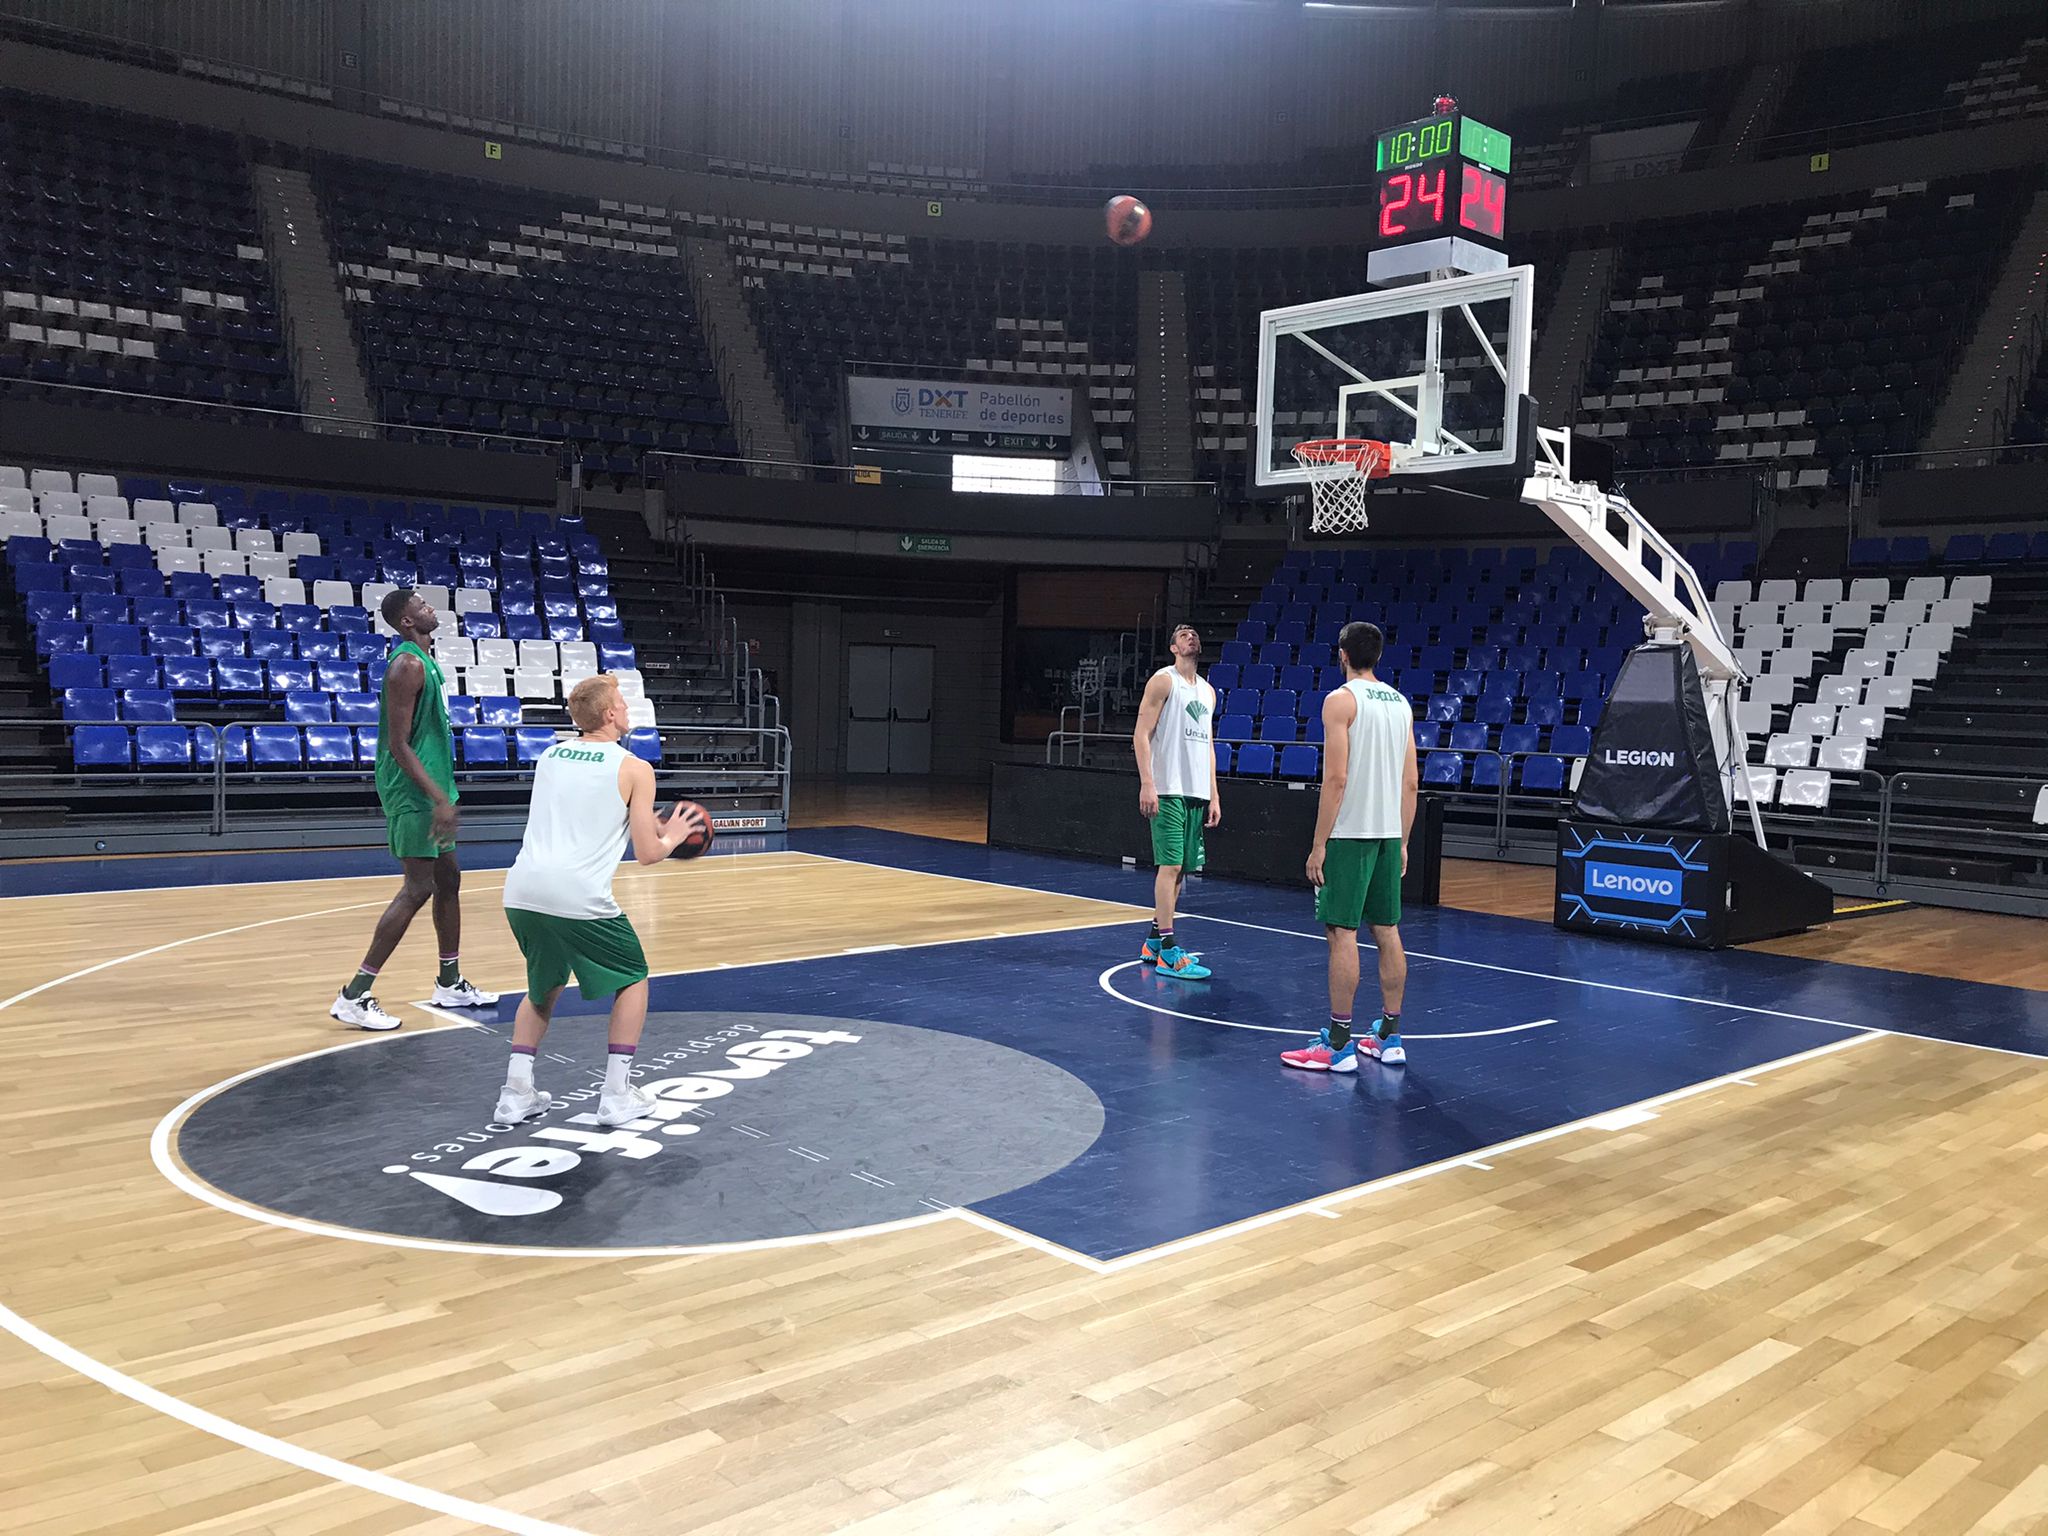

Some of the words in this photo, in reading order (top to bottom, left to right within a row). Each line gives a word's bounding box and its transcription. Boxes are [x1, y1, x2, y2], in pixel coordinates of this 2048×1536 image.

[1390, 121, 1453, 165] 10:00
[930, 203, 939, 214] G
[1380, 168, 1446, 236] 24
[1460, 167, 1505, 235] 24
[918, 388, 969, 409] DXT
[979, 391, 1041, 408] Pabellón
[919, 407, 969, 420] TENERIFE
[979, 407, 997, 421] de
[1001, 408, 1065, 425] deportes
[881, 430, 908, 440] SALIDA
[1003, 436, 1025, 447] EXIT
[1364, 687, 1403, 703] Joma
[547, 746, 606, 763] Joma
[1605, 749, 1675, 767] LEGION
[713, 819, 740, 828] GALVAN
[741, 818, 764, 827] SPORT
[1592, 868, 1674, 896] Lenovo
